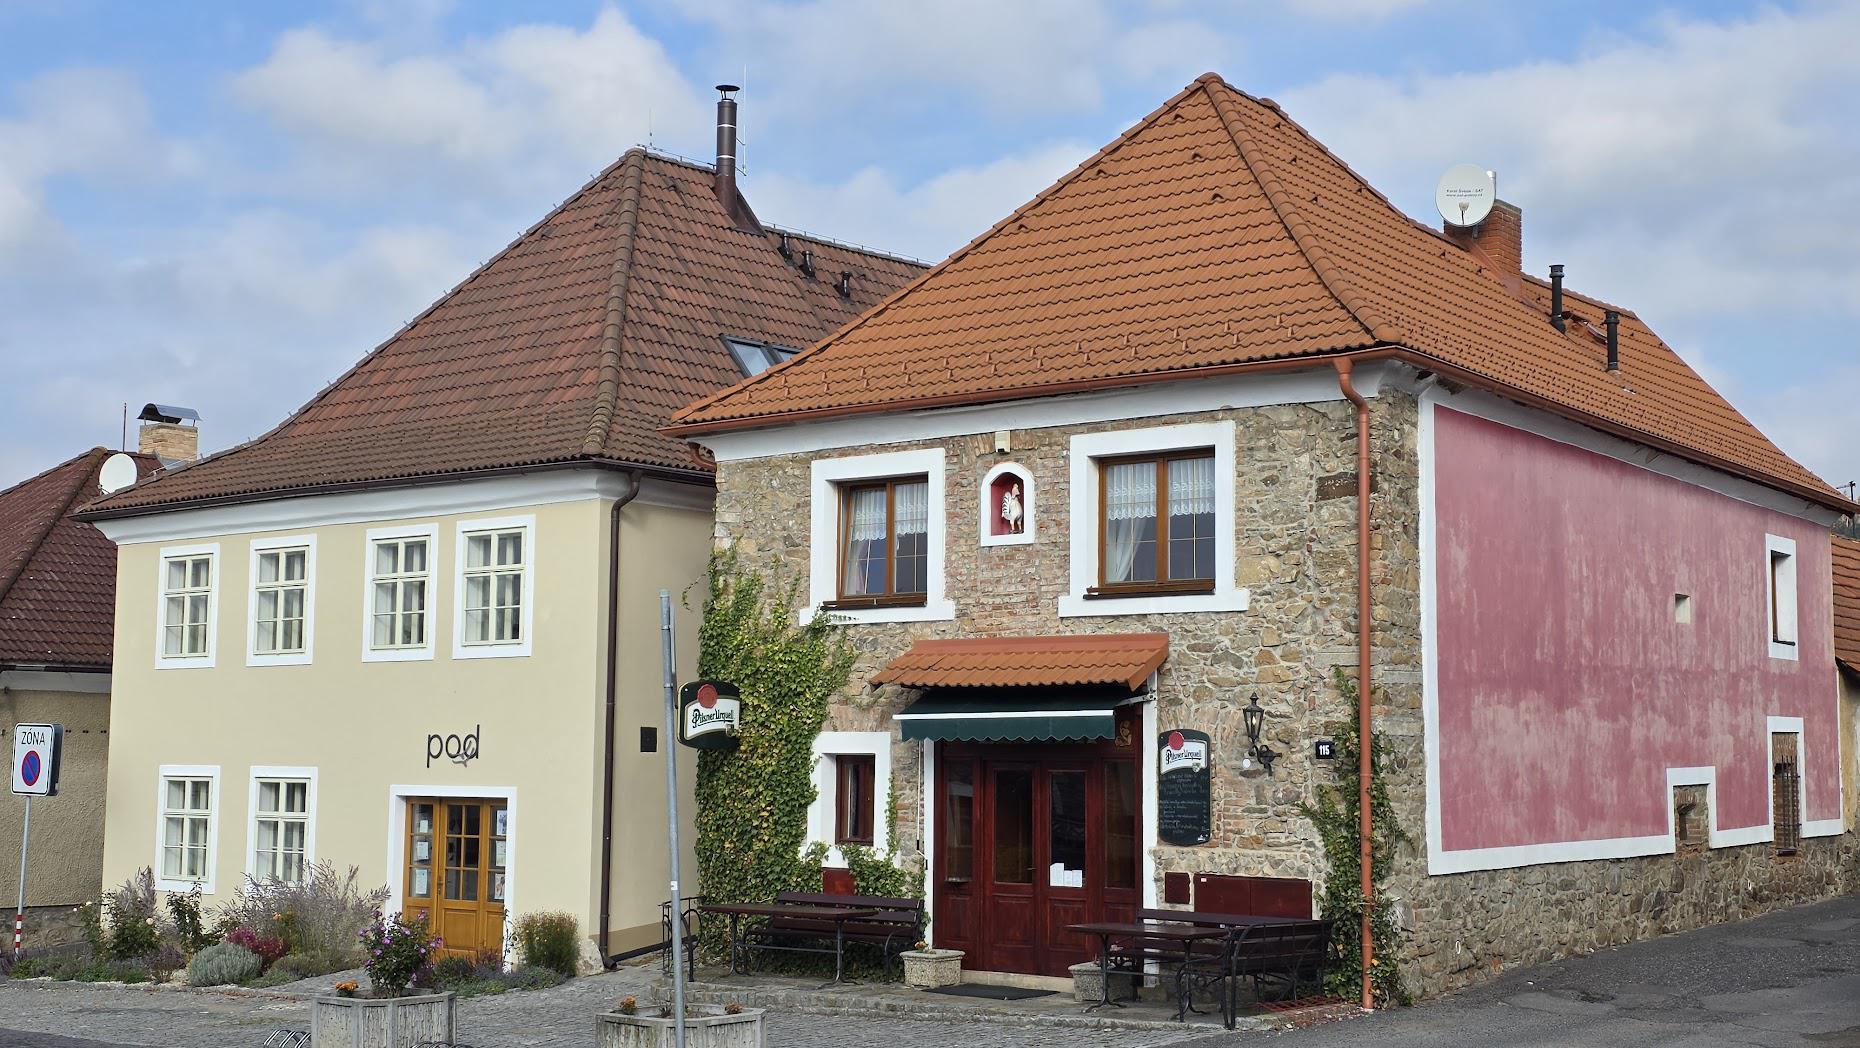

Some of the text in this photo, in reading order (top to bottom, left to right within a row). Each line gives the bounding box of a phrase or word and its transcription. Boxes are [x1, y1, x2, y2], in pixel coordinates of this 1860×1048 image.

[691, 708, 715, 729] Pilsner
[21, 727, 46, 746] ZÓNA
[426, 723, 480, 769] pod
[1319, 744, 1330, 756] 115
